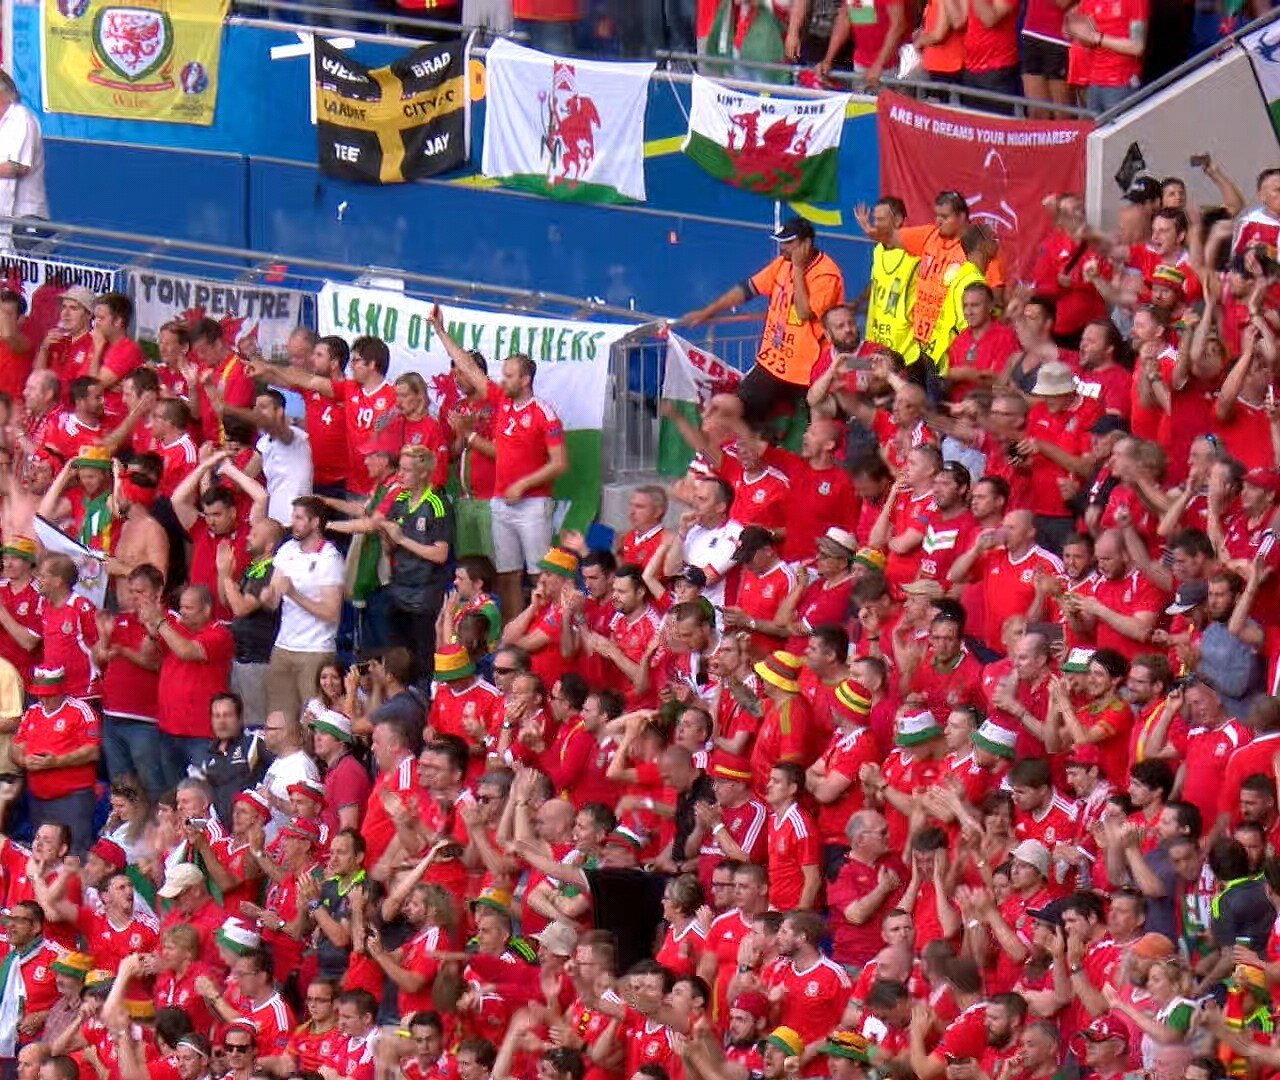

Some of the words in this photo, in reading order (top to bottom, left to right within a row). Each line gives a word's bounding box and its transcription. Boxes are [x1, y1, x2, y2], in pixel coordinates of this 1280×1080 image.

[411, 52, 451, 78] BRAD
[889, 105, 913, 126] ARE
[914, 114, 930, 130] MY
[932, 120, 975, 141] DREAMS
[977, 128, 1005, 145] YOUR
[333, 142, 361, 163] TEE
[424, 132, 450, 156] JAY
[44, 264, 112, 294] RHONDDA
[139, 274, 192, 308] TON
[194, 284, 291, 319] PENTRE
[332, 292, 398, 343] LAND
[447, 320, 485, 351] MY
[494, 325, 606, 362] FATHERS
[356, 408, 374, 429] 19
